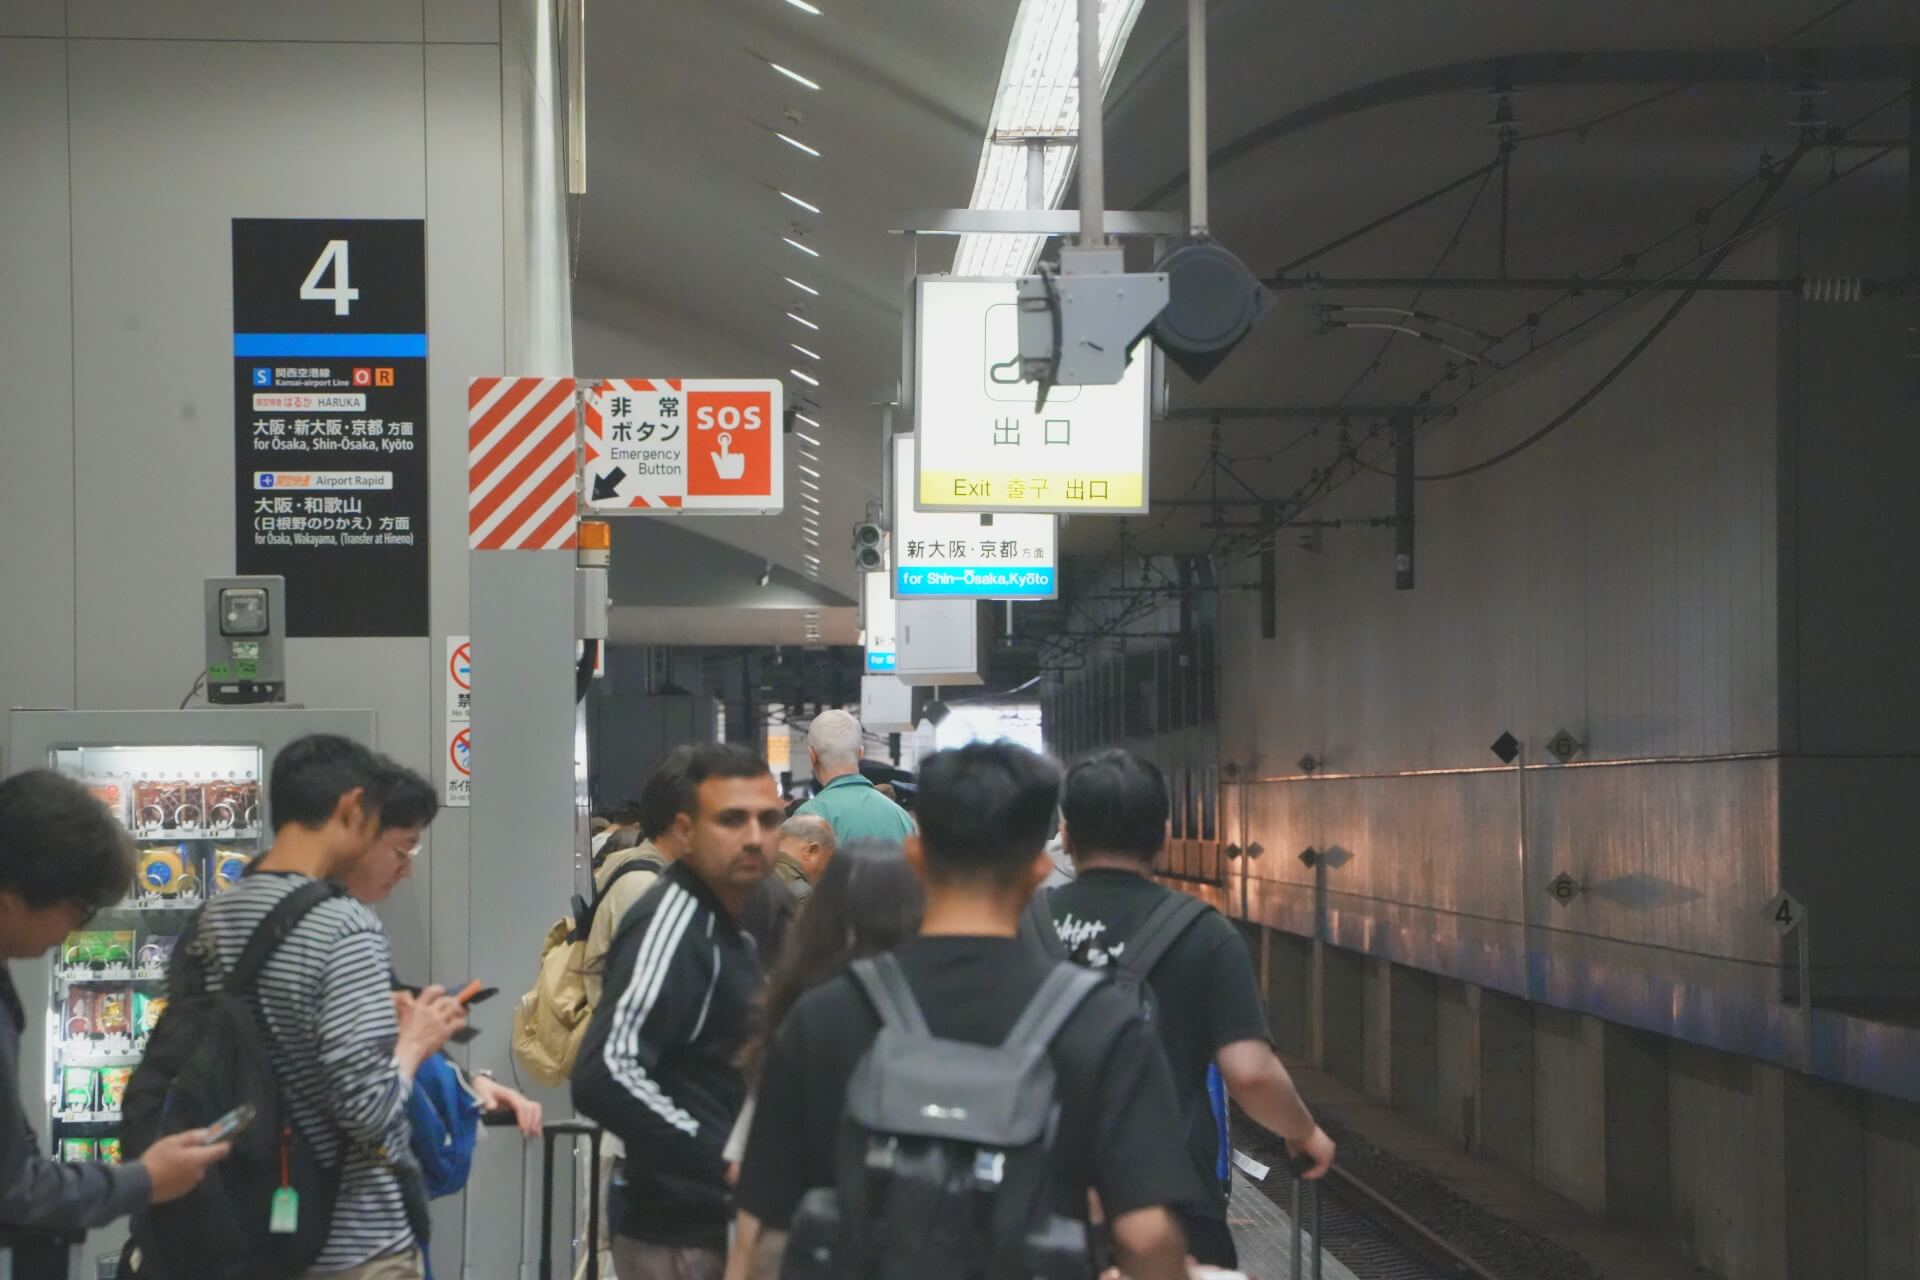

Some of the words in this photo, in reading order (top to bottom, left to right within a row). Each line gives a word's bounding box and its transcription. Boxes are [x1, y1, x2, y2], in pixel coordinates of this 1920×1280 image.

[299, 239, 360, 316] 4
[257, 369, 267, 384] S
[355, 370, 369, 384] O
[379, 370, 390, 384] R
[318, 397, 361, 408] HARUKA
[696, 405, 762, 431] SOS
[611, 420, 681, 443] ボタン
[254, 438, 269, 450] for
[271, 436, 310, 452] Ōsaka,
[382, 437, 414, 453] Kyōto
[610, 447, 681, 461] Emergency
[638, 462, 682, 476] Button
[316, 475, 352, 487] Airport
[355, 475, 385, 487] Rapid
[953, 478, 991, 497] Exit
[1007, 477, 1049, 500] 출구
[1065, 478, 1109, 501] 出口
[255, 532, 266, 545] for
[902, 572, 924, 585] for
[1555, 879, 1572, 898] 6
[1775, 899, 1792, 926] 4
